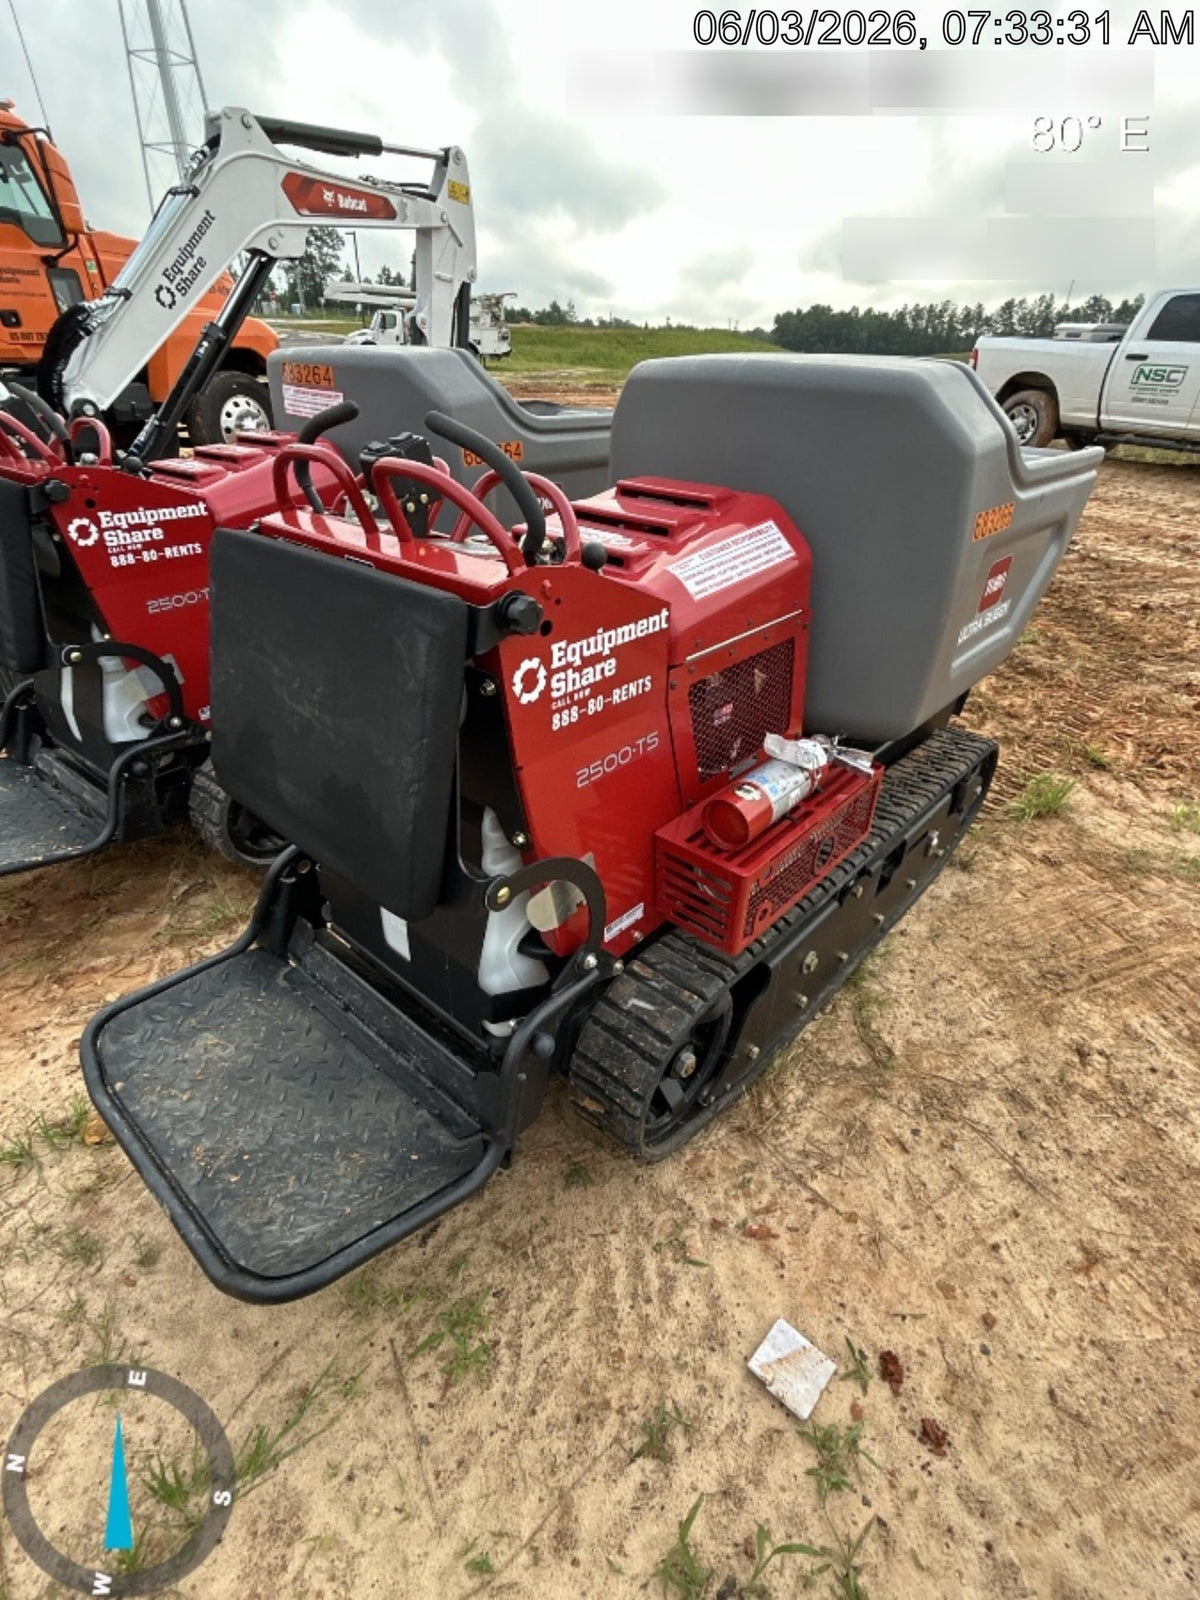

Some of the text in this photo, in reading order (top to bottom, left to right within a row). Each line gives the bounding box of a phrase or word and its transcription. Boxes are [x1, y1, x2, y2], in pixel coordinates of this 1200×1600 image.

[338, 194, 368, 213] Bobcat
[162, 209, 216, 285] Equipment
[0, 266, 40, 276] quipment
[175, 255, 207, 298] Share
[1135, 366, 1187, 384] NSC
[97, 500, 208, 529] Equipment
[103, 526, 164, 547] Share
[110, 541, 202, 568] 888-80-RENTS
[550, 607, 669, 669] Equipment
[550, 657, 617, 699] Share
[551, 697, 572, 710] CALL
[551, 675, 652, 732] 888-80-RENTS
